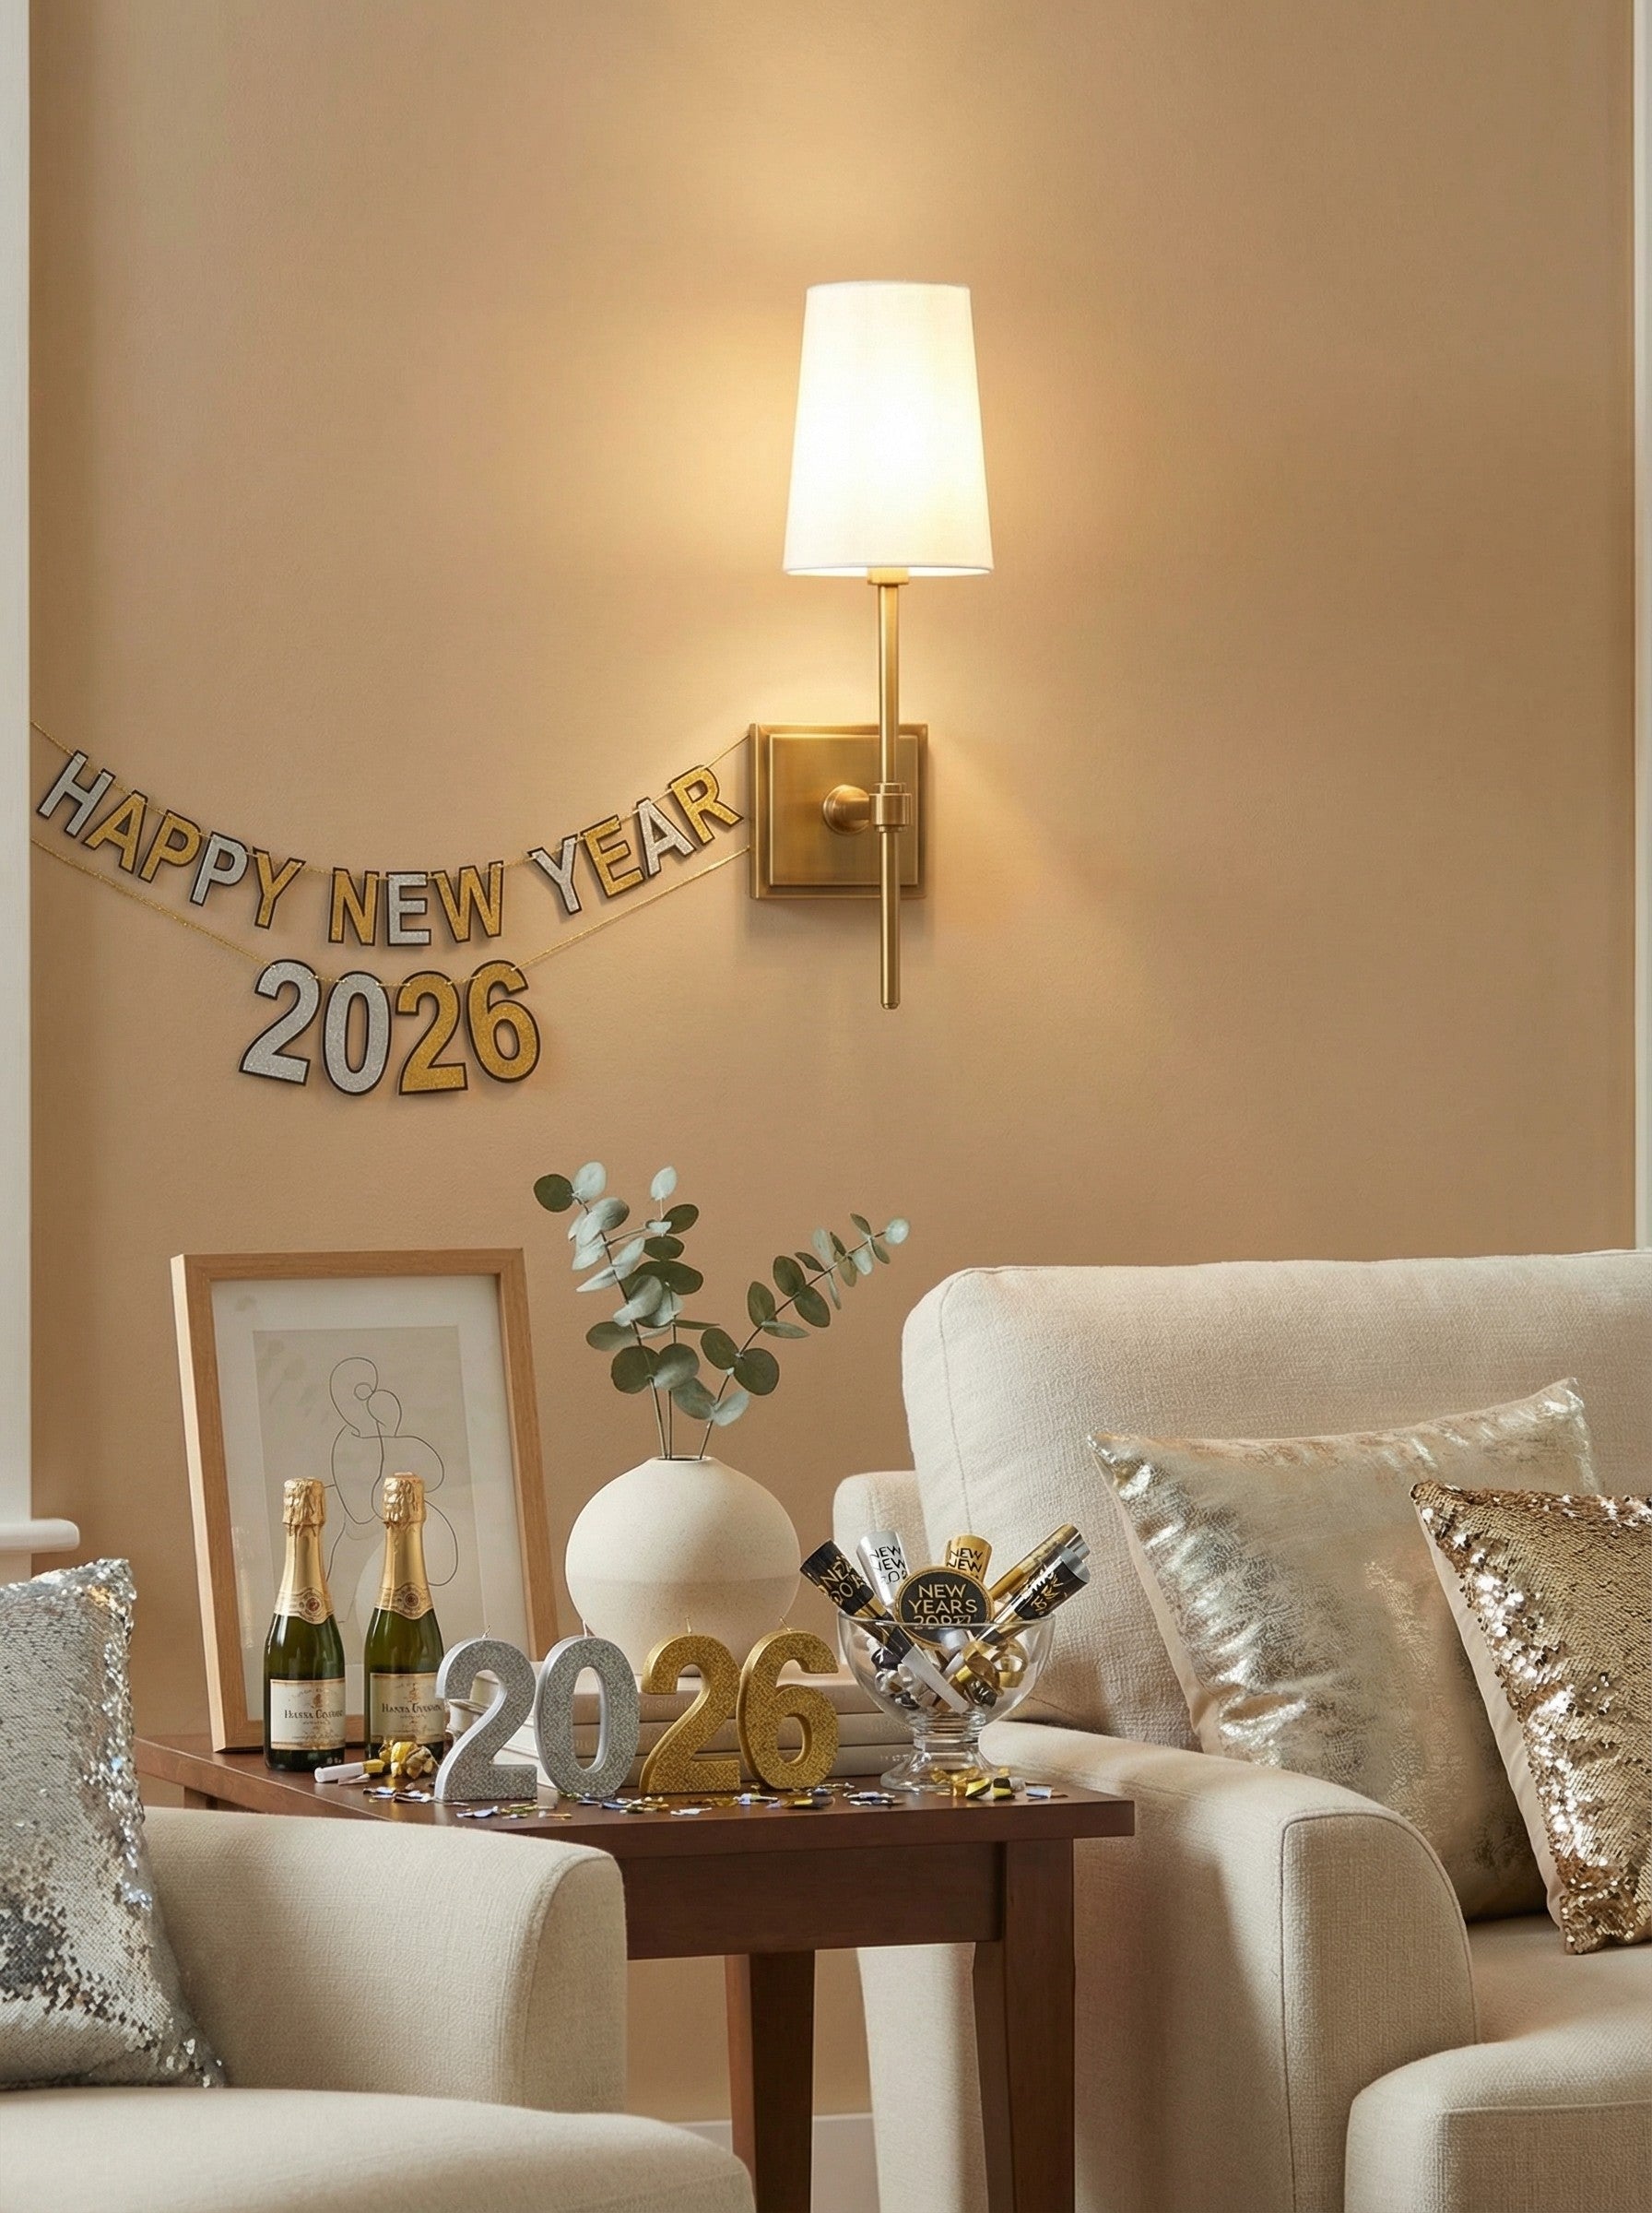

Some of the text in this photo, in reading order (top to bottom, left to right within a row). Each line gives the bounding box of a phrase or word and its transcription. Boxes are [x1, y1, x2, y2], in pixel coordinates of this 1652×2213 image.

[37, 750, 744, 946] HAPPY NEW YEAR
[238, 959, 541, 1095] 2026
[917, 1583, 967, 1599] NEW
[949, 1546, 984, 1561] NEW
[907, 1598, 978, 1615] YEARS
[433, 1629, 840, 1801] 2026
